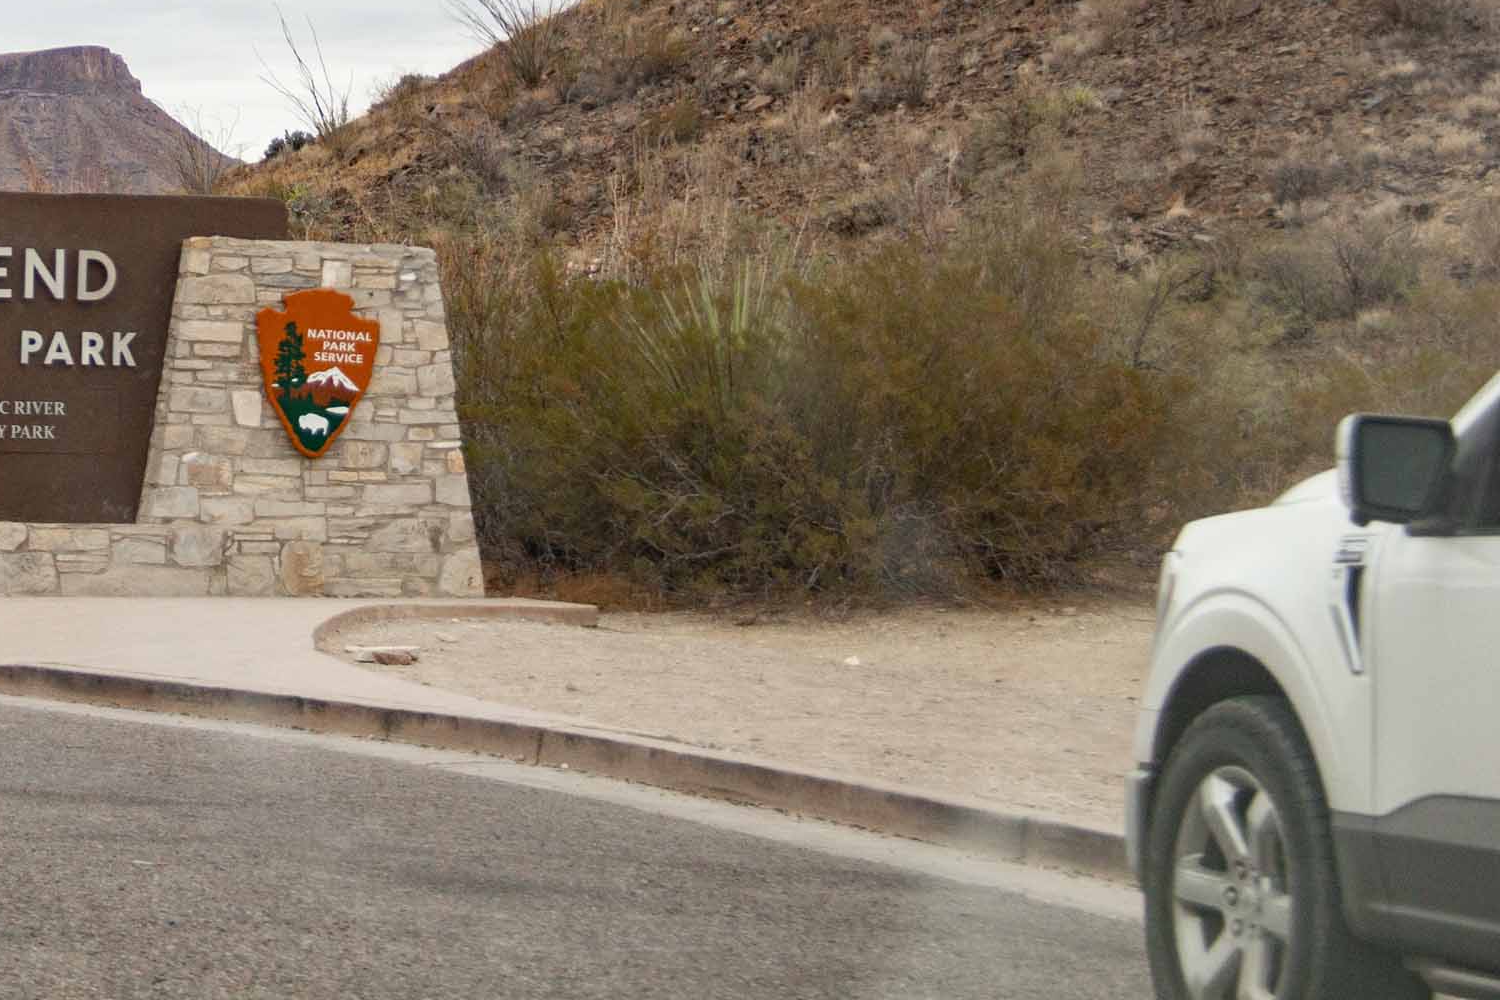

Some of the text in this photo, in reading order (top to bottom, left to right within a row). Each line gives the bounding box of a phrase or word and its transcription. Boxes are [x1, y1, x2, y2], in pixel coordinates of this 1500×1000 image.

[307, 328, 372, 342] NATIONAL
[20, 330, 136, 367] PARK
[323, 341, 356, 352] PARK
[314, 351, 363, 364] SERVICE
[14, 400, 65, 416] RIVER
[11, 424, 55, 439] PARK
